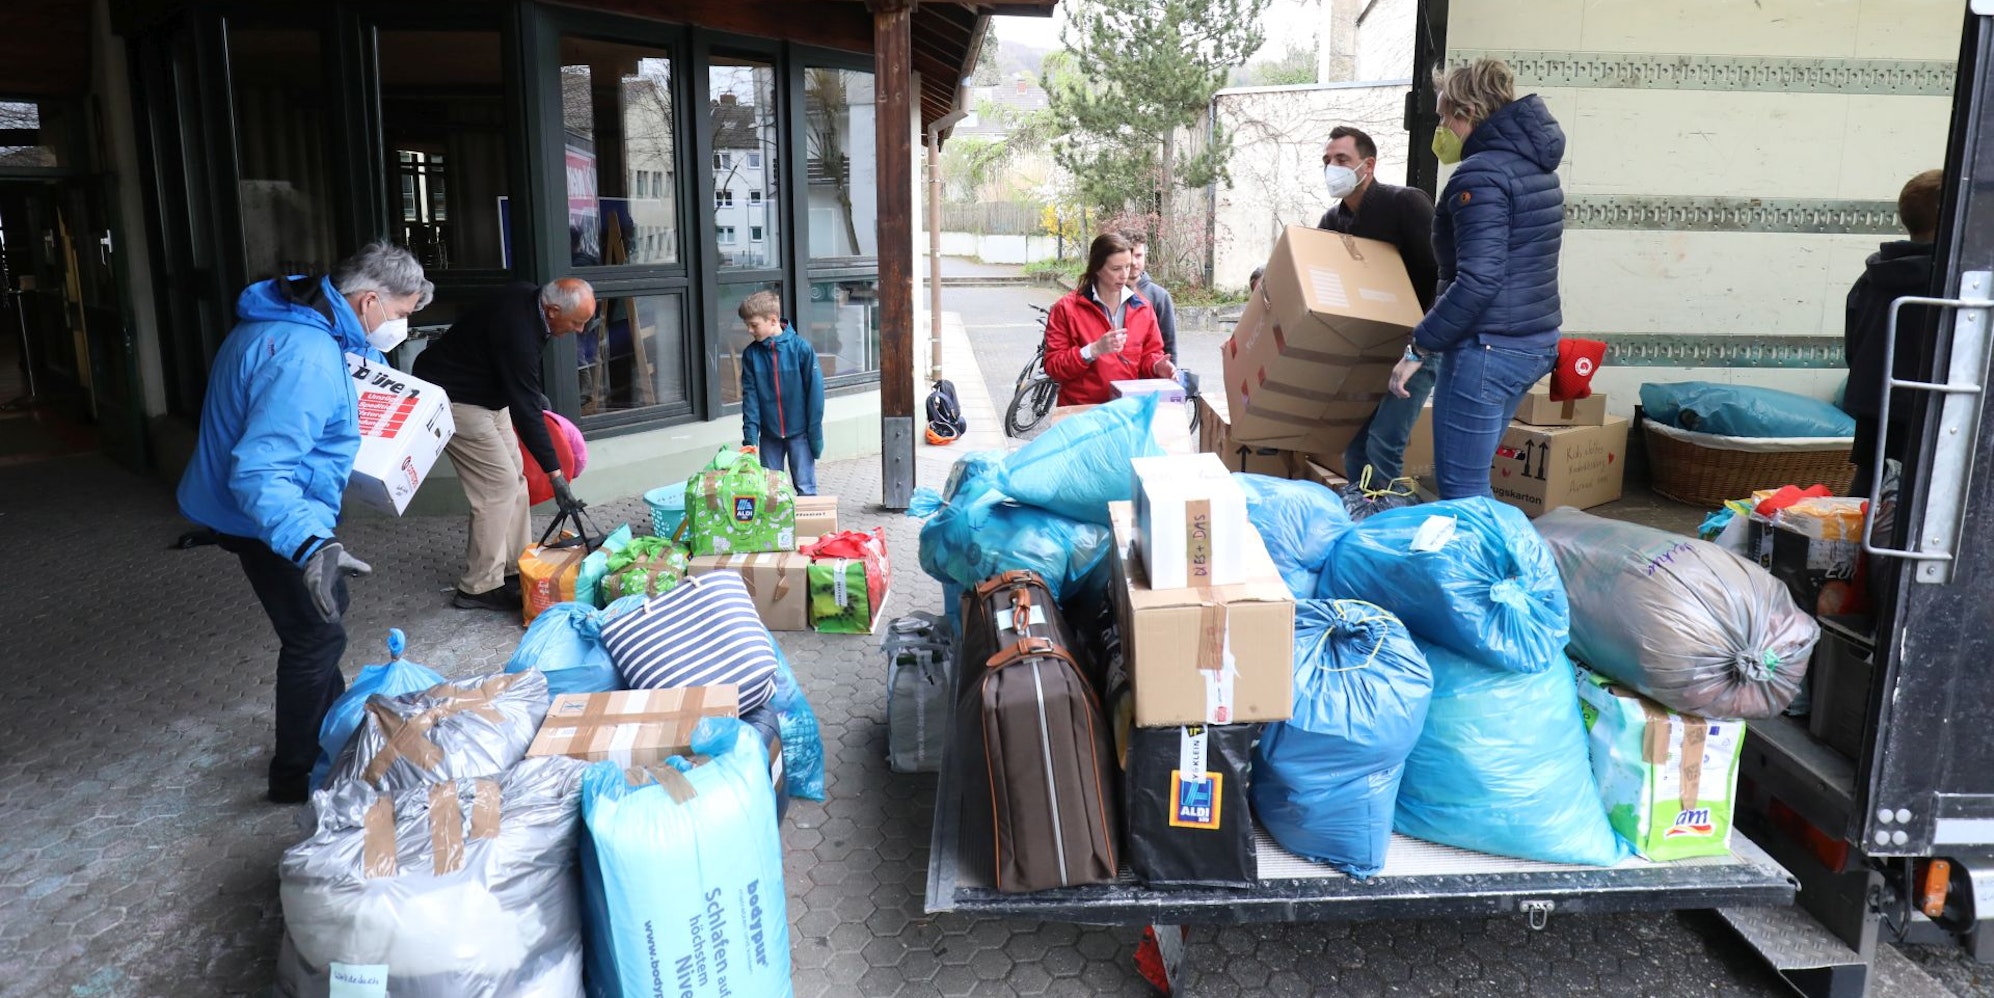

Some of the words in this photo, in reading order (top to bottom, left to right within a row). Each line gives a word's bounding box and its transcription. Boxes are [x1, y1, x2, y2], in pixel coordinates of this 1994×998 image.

[1491, 486, 1542, 504] ugskarton
[1180, 805, 1210, 817] ALDI
[1675, 808, 1709, 827] dm
[705, 887, 730, 974] Schlafen
[747, 878, 767, 967] bodypur
[689, 914, 708, 987] höchstem
[717, 975, 732, 998] auf
